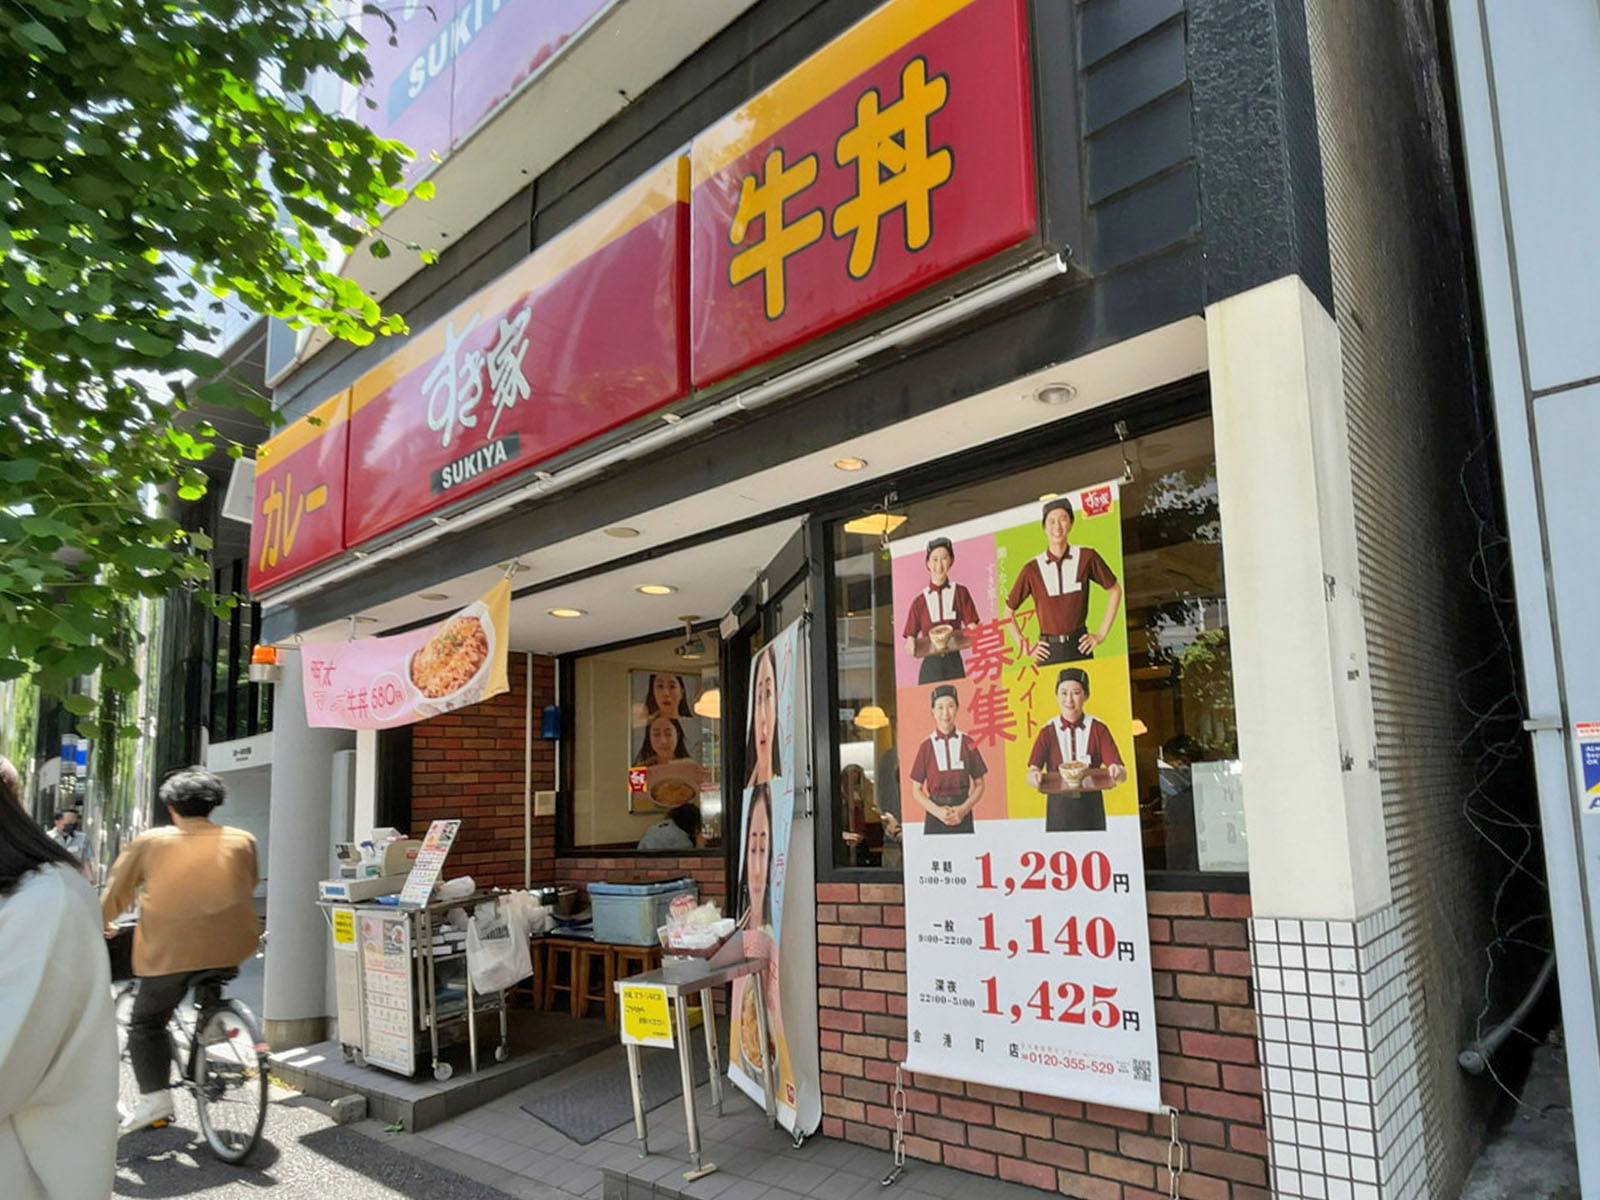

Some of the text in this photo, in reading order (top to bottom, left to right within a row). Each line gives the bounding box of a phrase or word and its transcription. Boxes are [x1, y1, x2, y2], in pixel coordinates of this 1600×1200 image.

[728, 53, 955, 321] 牛丼
[421, 306, 532, 447] すき家
[259, 472, 328, 573] カレー
[441, 441, 508, 490] SUKIYA
[963, 617, 1018, 751] 募集
[1029, 1052, 1115, 1075] 0120-355-529
